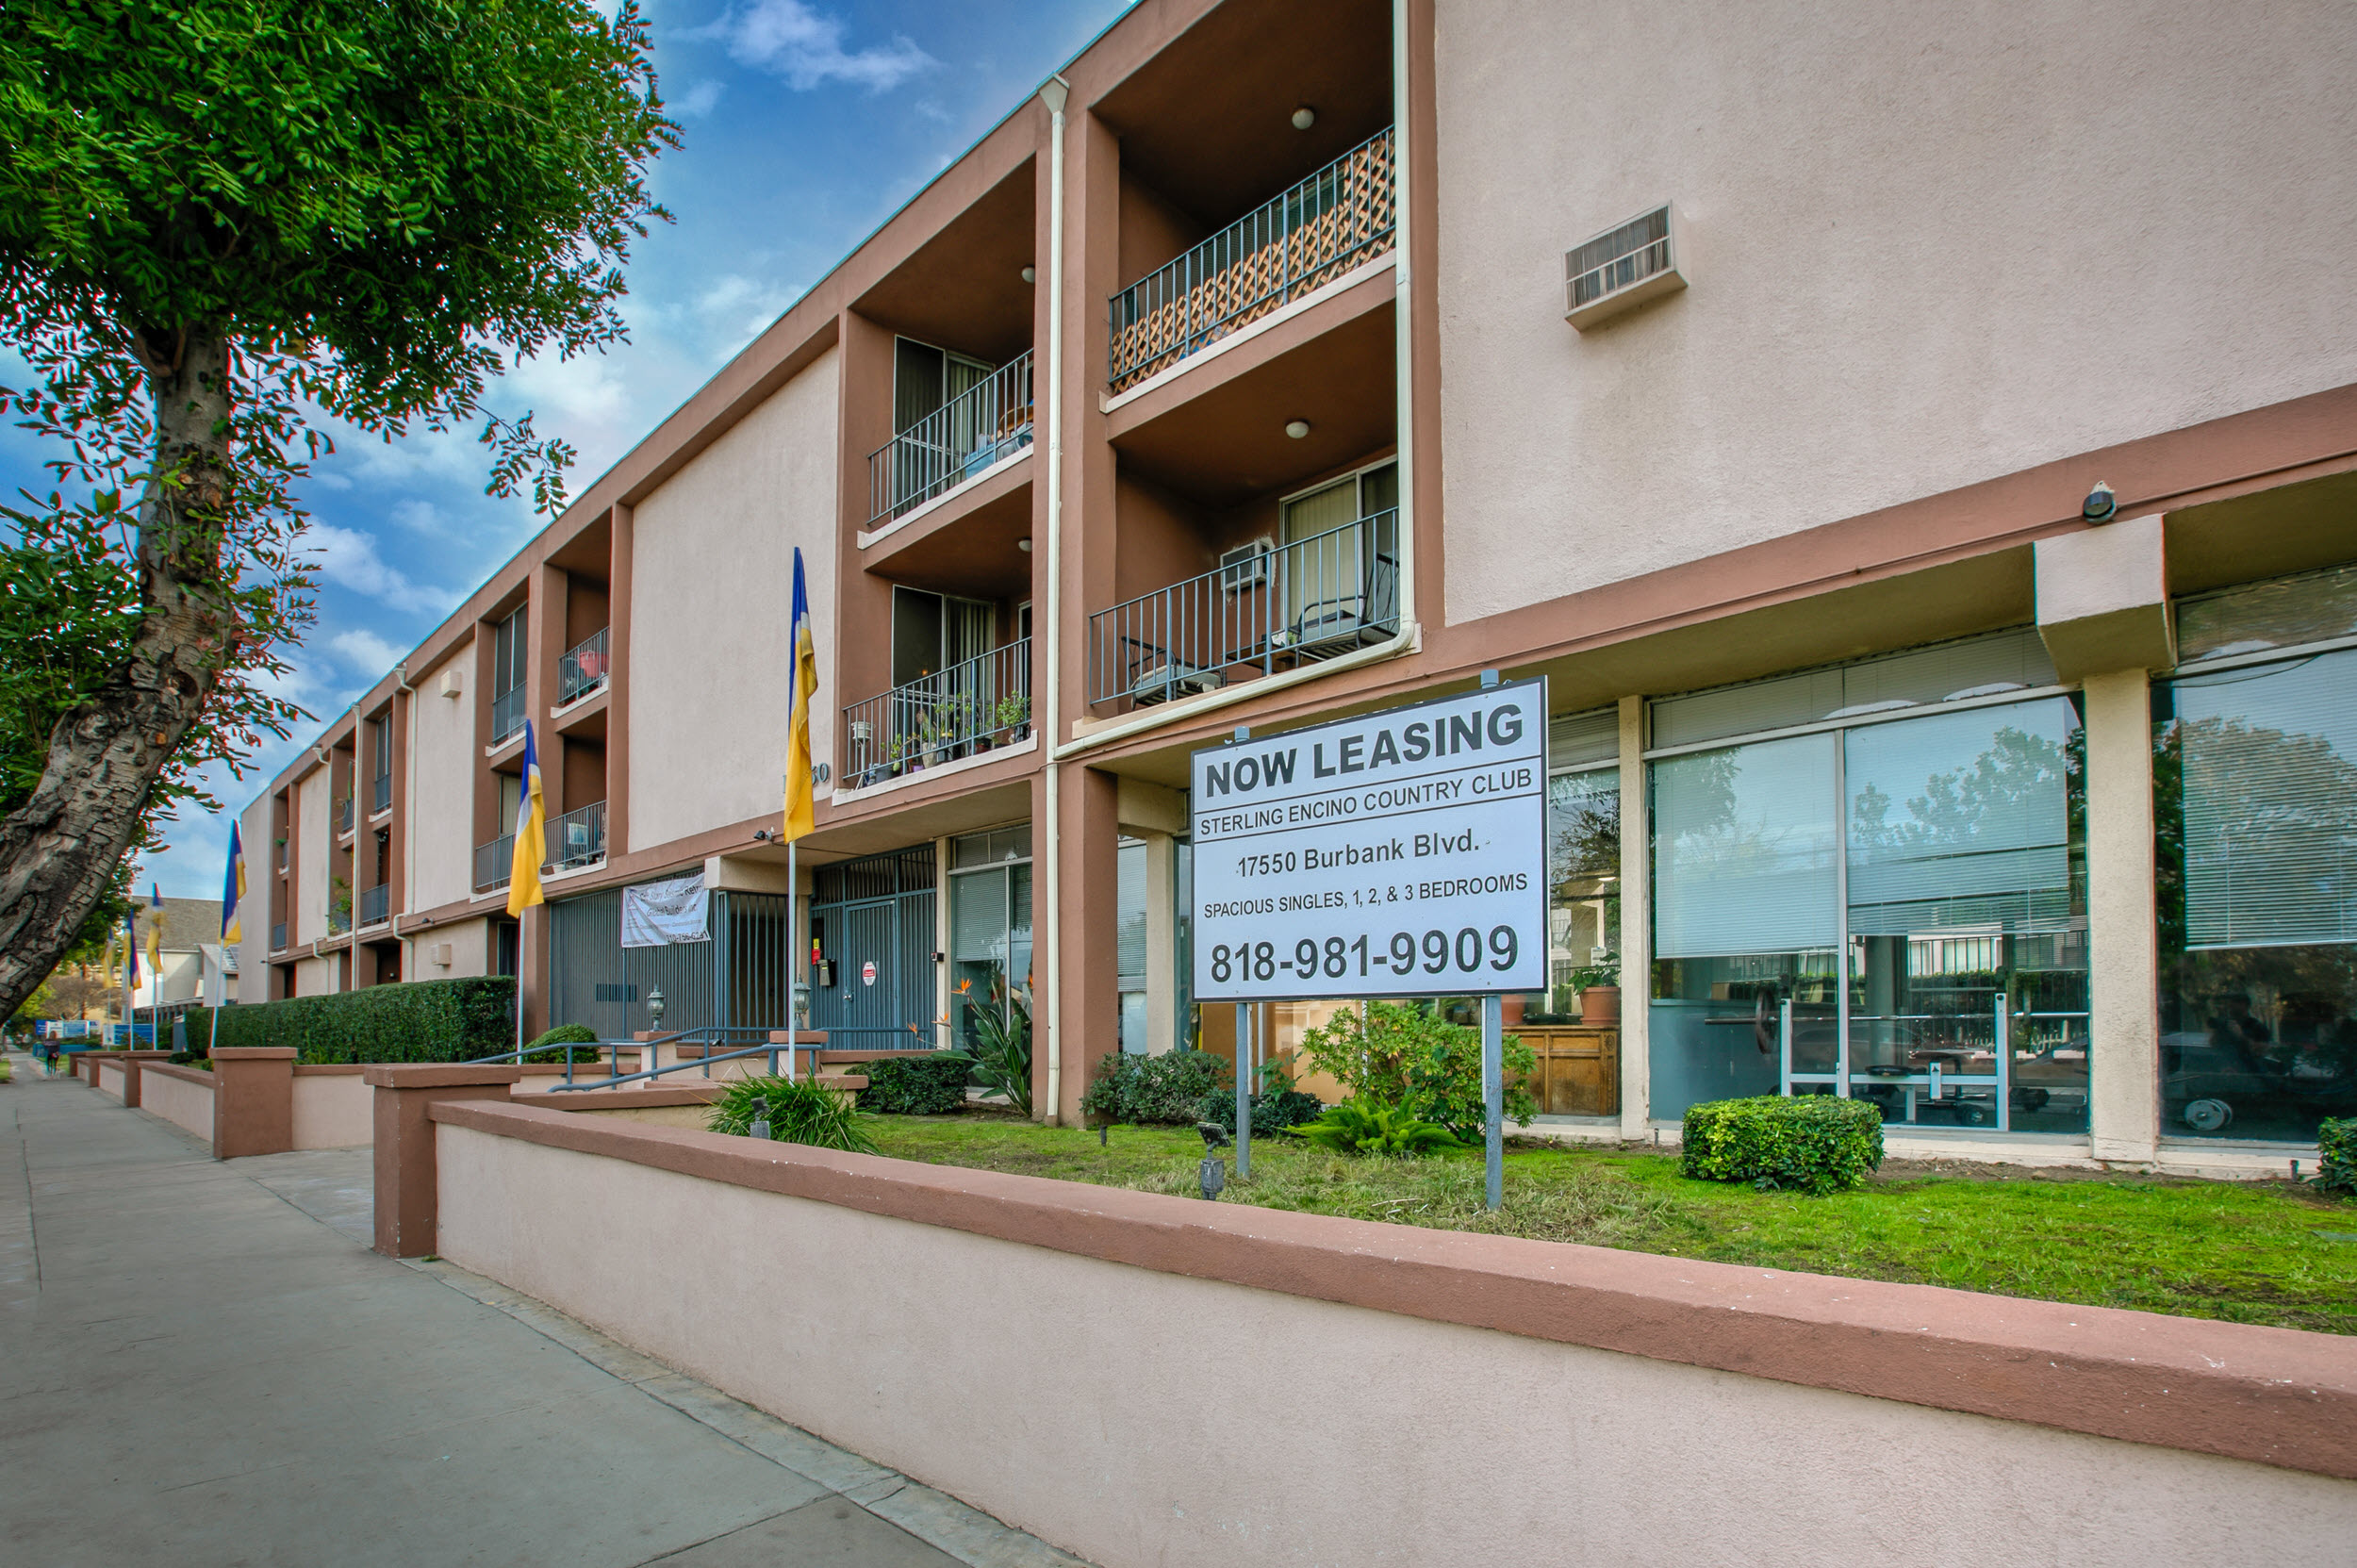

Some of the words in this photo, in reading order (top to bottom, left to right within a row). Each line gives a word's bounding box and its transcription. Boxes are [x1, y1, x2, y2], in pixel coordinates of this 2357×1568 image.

[1206, 748, 1297, 798] NOW
[1313, 703, 1523, 779] LEASING
[1200, 808, 1283, 835] STERLING
[1289, 796, 1357, 823] ENCINO
[1363, 778, 1463, 811] COUNTRY
[1472, 767, 1532, 795] CLUB
[1238, 851, 1296, 878] 17550
[1304, 837, 1405, 870] Burbank
[1414, 828, 1479, 858] Blvd.
[1204, 898, 1274, 918] SPACIOUS
[1278, 889, 1348, 913] SINGLES,
[1352, 889, 1363, 908] 1,
[1368, 887, 1382, 906] 2,
[1386, 885, 1398, 902] &
[1405, 884, 1413, 901] 3
[1419, 873, 1527, 900] BEDROOMS
[1211, 925, 1518, 983] 818-981-9909
